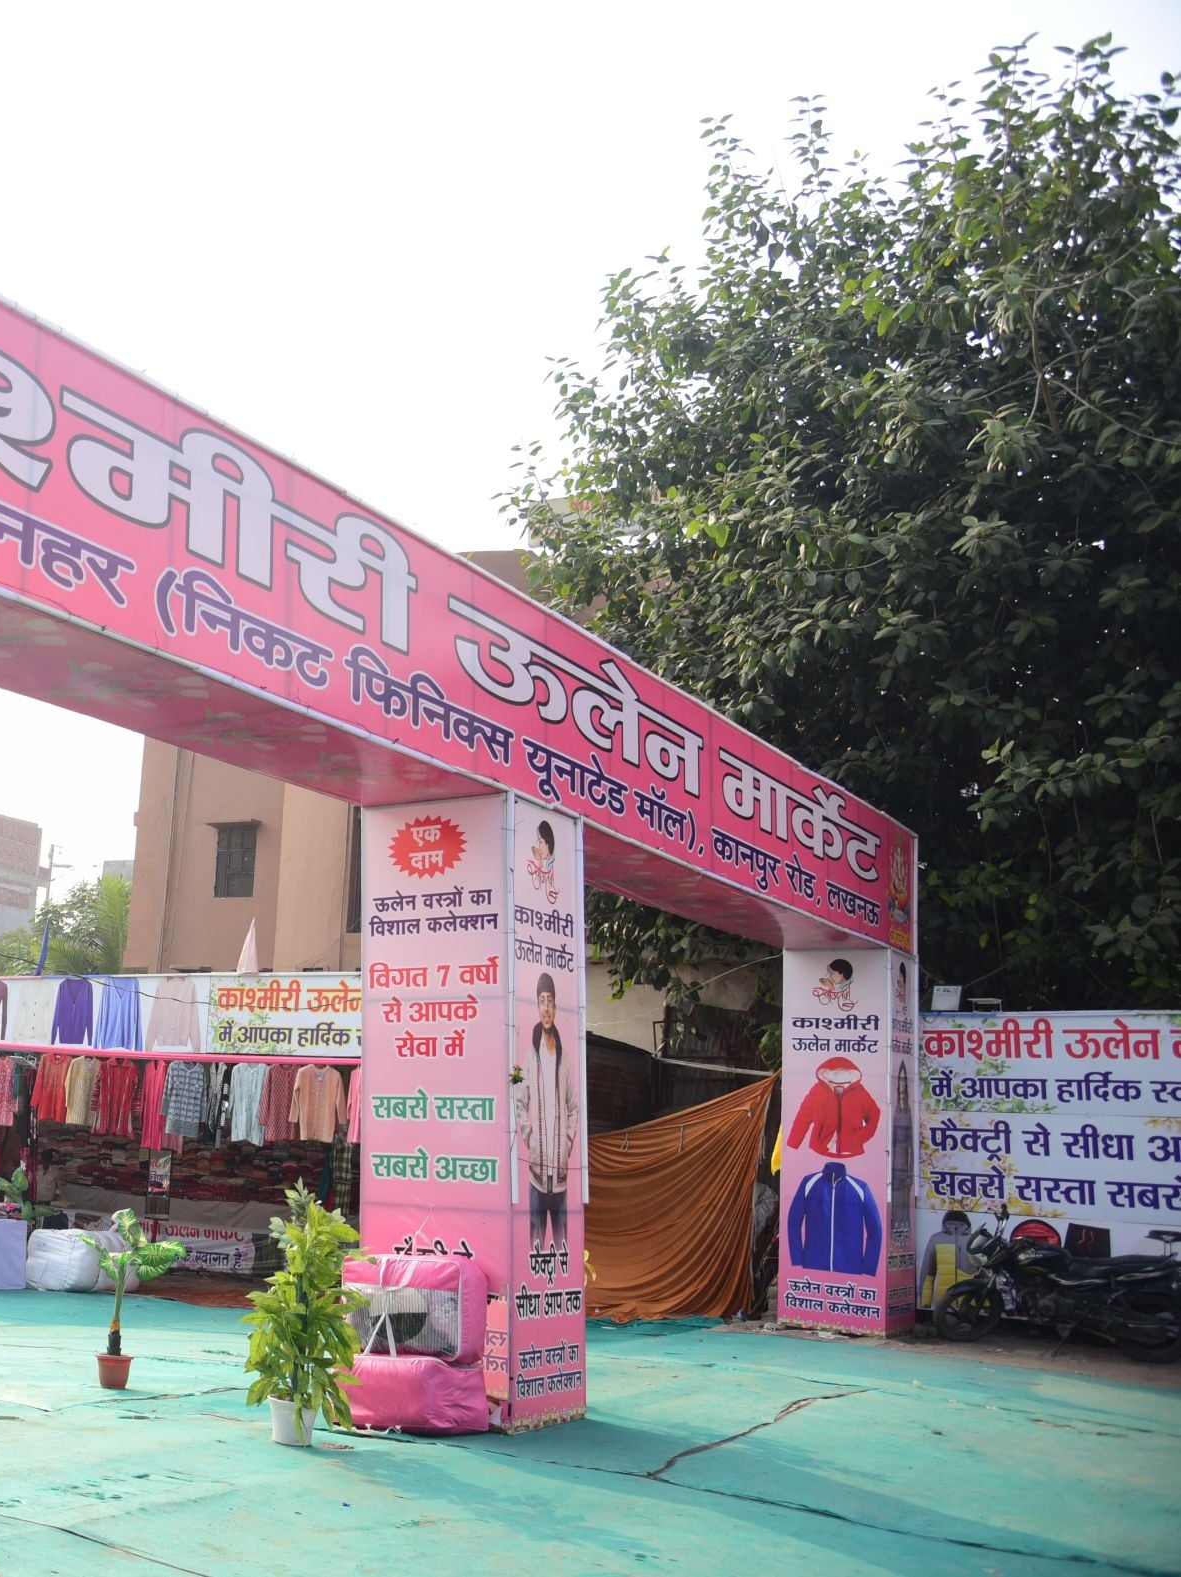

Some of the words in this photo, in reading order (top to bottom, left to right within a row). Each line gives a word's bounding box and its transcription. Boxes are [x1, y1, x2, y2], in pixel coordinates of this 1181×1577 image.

[447, 594, 704, 798] ऊलेन
[718, 747, 882, 882] मार्केट
[344, 645, 514, 765] फिनिक्स
[521, 736, 630, 816] यूनाटेड
[711, 827, 782, 892] कानपुर
[825, 880, 882, 928] लखनऊ
[410, 823, 442, 846] एक
[409, 850, 444, 869] दाम
[372, 890, 417, 912] ऊलेन
[421, 885, 464, 910] वस्त्रों
[468, 888, 493, 906] का
[368, 915, 421, 937] विशाल
[425, 910, 499, 933] कलेक्शन
[514, 904, 574, 938] काश्मीरी
[515, 935, 543, 966] ऊलेन
[544, 943, 574, 973] मार्केट
[368, 962, 429, 989] विगत
[436, 964, 451, 987] 7
[218, 979, 302, 1014] काश्मीरी
[382, 996, 402, 1023] से
[408, 994, 479, 1023] आपके
[219, 1020, 236, 1042] में
[237, 1025, 293, 1046] आपका
[297, 1022, 351, 1047] हार्दिक
[791, 1014, 880, 1031] काश्मीरी
[395, 1030, 438, 1058] सेवा
[444, 1029, 466, 1057] में
[791, 1034, 830, 1053] ऊलेन
[834, 1034, 880, 1053] मार्केट
[923, 1018, 1053, 1061] काश्मीरी
[1065, 1018, 1160, 1060] ऊलेन
[930, 1069, 954, 1099] में
[960, 1076, 1047, 1100] आपका
[1056, 1071, 1142, 1102] हार्दिक
[372, 1087, 428, 1120] सबसे
[434, 1097, 495, 1121] सस्ता
[929, 1118, 1011, 1161] फैक्ट्री
[1022, 1122, 1050, 1156] से
[1061, 1123, 1134, 1161] सीधा
[372, 1146, 428, 1180] सबसे
[435, 1156, 498, 1182] अच्छा
[931, 1165, 1006, 1200] सबसे
[1014, 1175, 1096, 1206] सस्ता
[559, 1242, 568, 1274] से
[515, 1285, 540, 1319] सीधा
[544, 1290, 563, 1317] आप
[565, 1289, 582, 1315] तक
[788, 1277, 821, 1295] ऊलेन
[825, 1283, 855, 1299] वस्त्रों
[859, 1288, 877, 1302] का
[785, 1293, 823, 1312] विशाल
[827, 1300, 881, 1319] कलेक्शन
[518, 1344, 543, 1370] ऊलेन
[568, 1344, 580, 1363] का
[516, 1374, 545, 1399] विशाल
